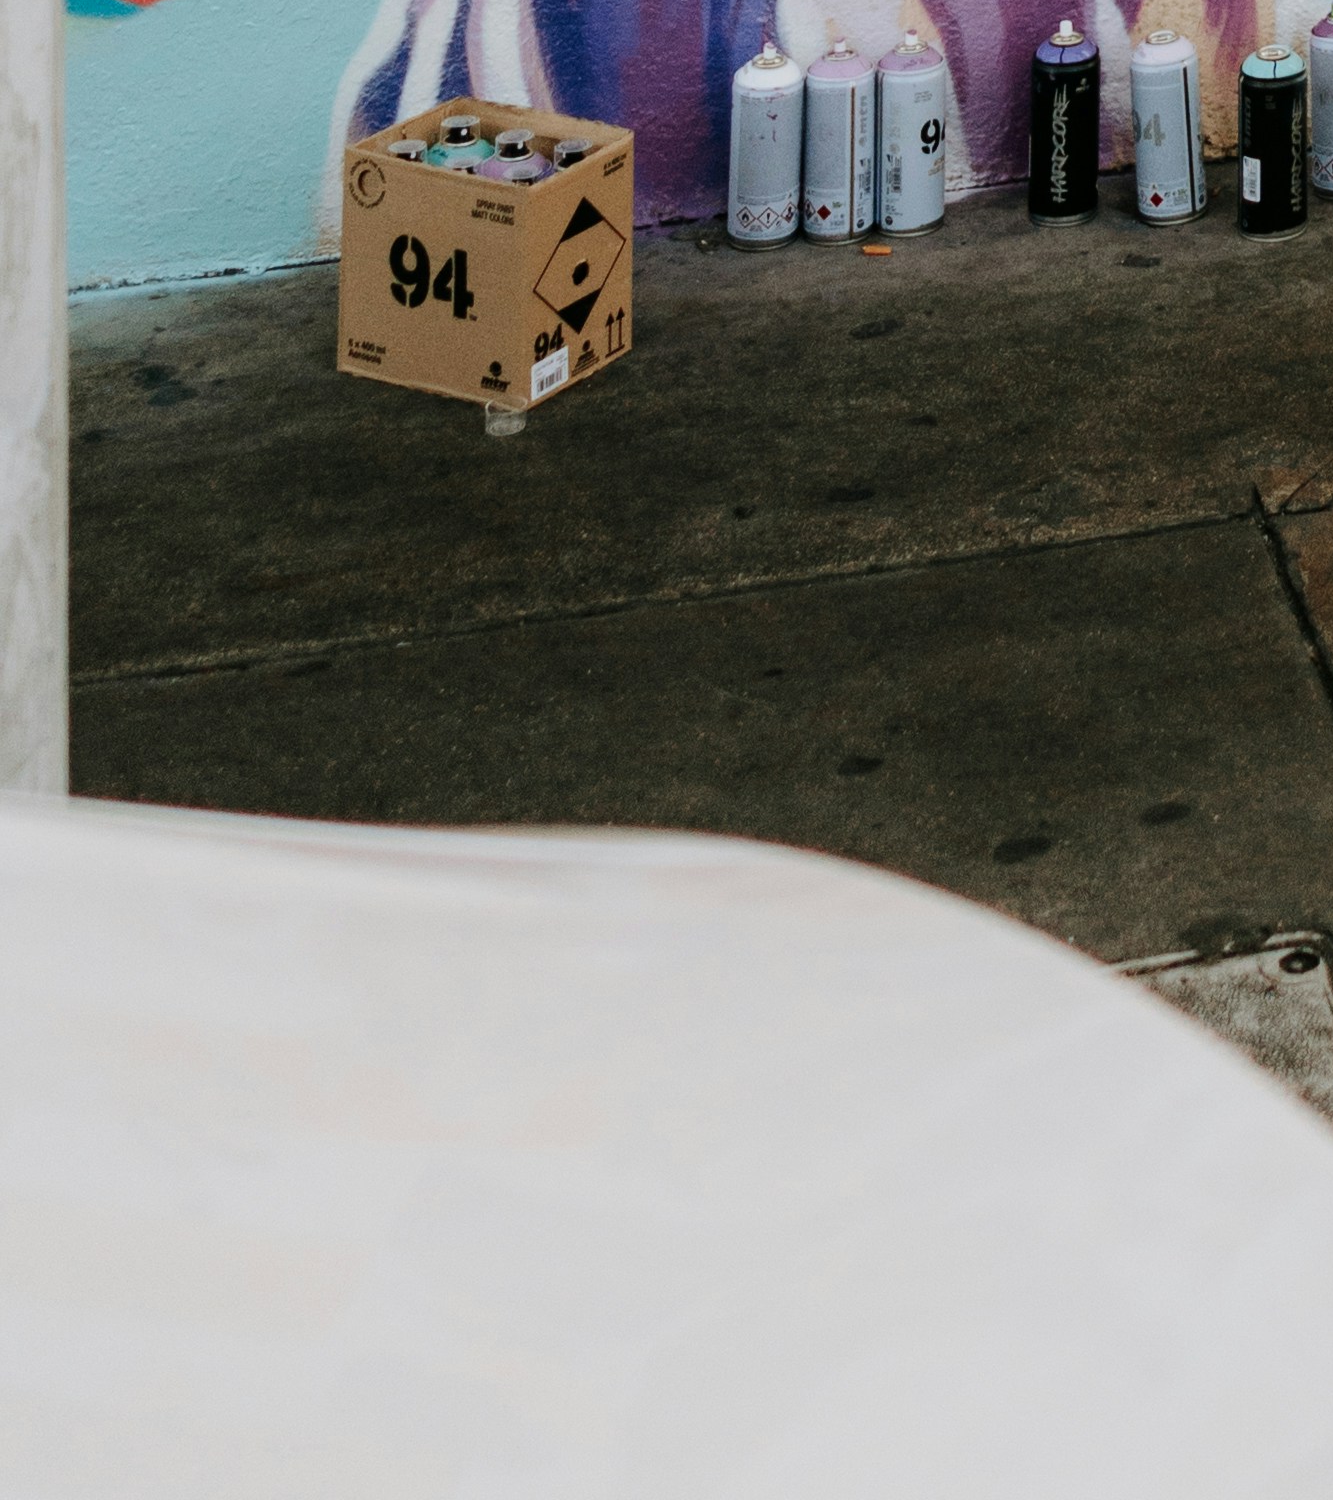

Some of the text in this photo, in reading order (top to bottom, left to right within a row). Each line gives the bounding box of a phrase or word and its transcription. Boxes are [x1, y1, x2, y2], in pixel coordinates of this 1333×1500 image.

[920, 118, 945, 155] 9
[1052, 83, 1070, 203] HARDCORE
[471, 208, 515, 226] MATT COLORS
[476, 198, 515, 214] SPRAY PAINT
[389, 234, 475, 320] 94
[534, 322, 564, 362] 94
[480, 375, 511, 393] mtn
